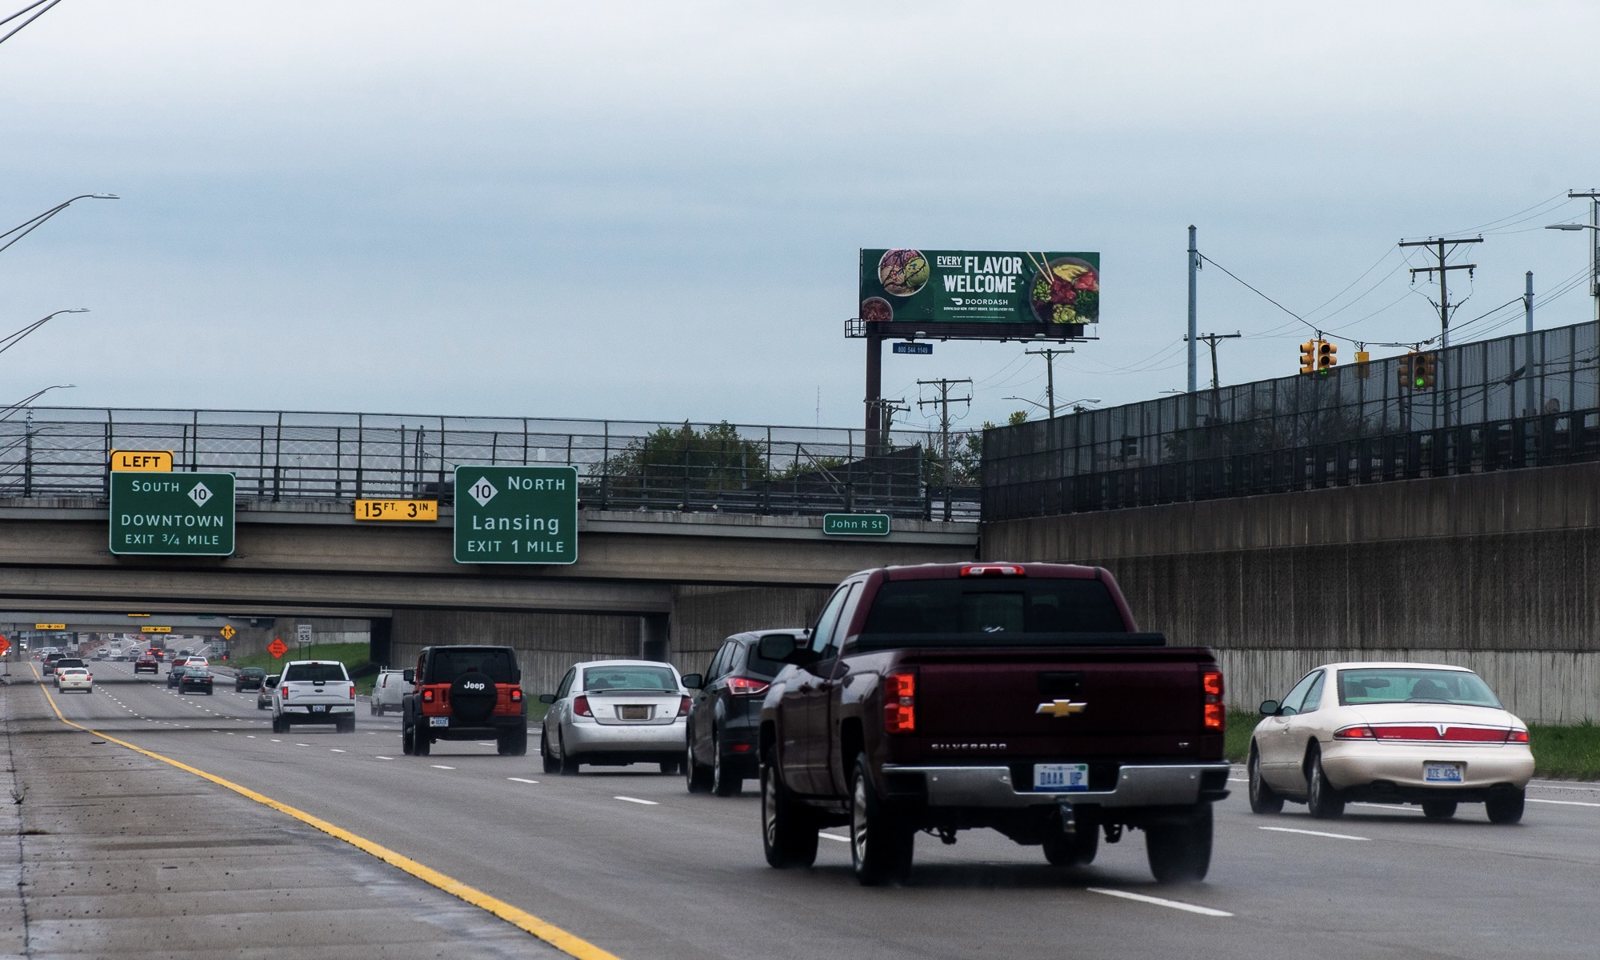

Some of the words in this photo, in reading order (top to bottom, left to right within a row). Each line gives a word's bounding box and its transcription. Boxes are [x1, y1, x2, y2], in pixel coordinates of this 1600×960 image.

[937, 256, 962, 265] EVERY
[964, 256, 1023, 274] FLAVOR
[943, 275, 1017, 293] WELCOME
[122, 456, 161, 468] LEFT
[132, 480, 180, 492] SOUTH
[193, 488, 207, 500] 10
[508, 476, 566, 490] NORTH
[474, 485, 492, 499] 10
[365, 502, 383, 517] 15
[407, 503, 418, 518] 3
[121, 514, 224, 527] DOWNTOWN
[472, 514, 560, 535] Lansing
[831, 520, 858, 529] John
[861, 520, 868, 529] R
[871, 520, 882, 529] St
[125, 534, 155, 544] EXIT
[187, 535, 220, 545] MILE
[467, 540, 502, 552] EXIT
[511, 540, 519, 553] 1
[527, 541, 565, 553] MILE
[464, 681, 485, 691] Jeep
